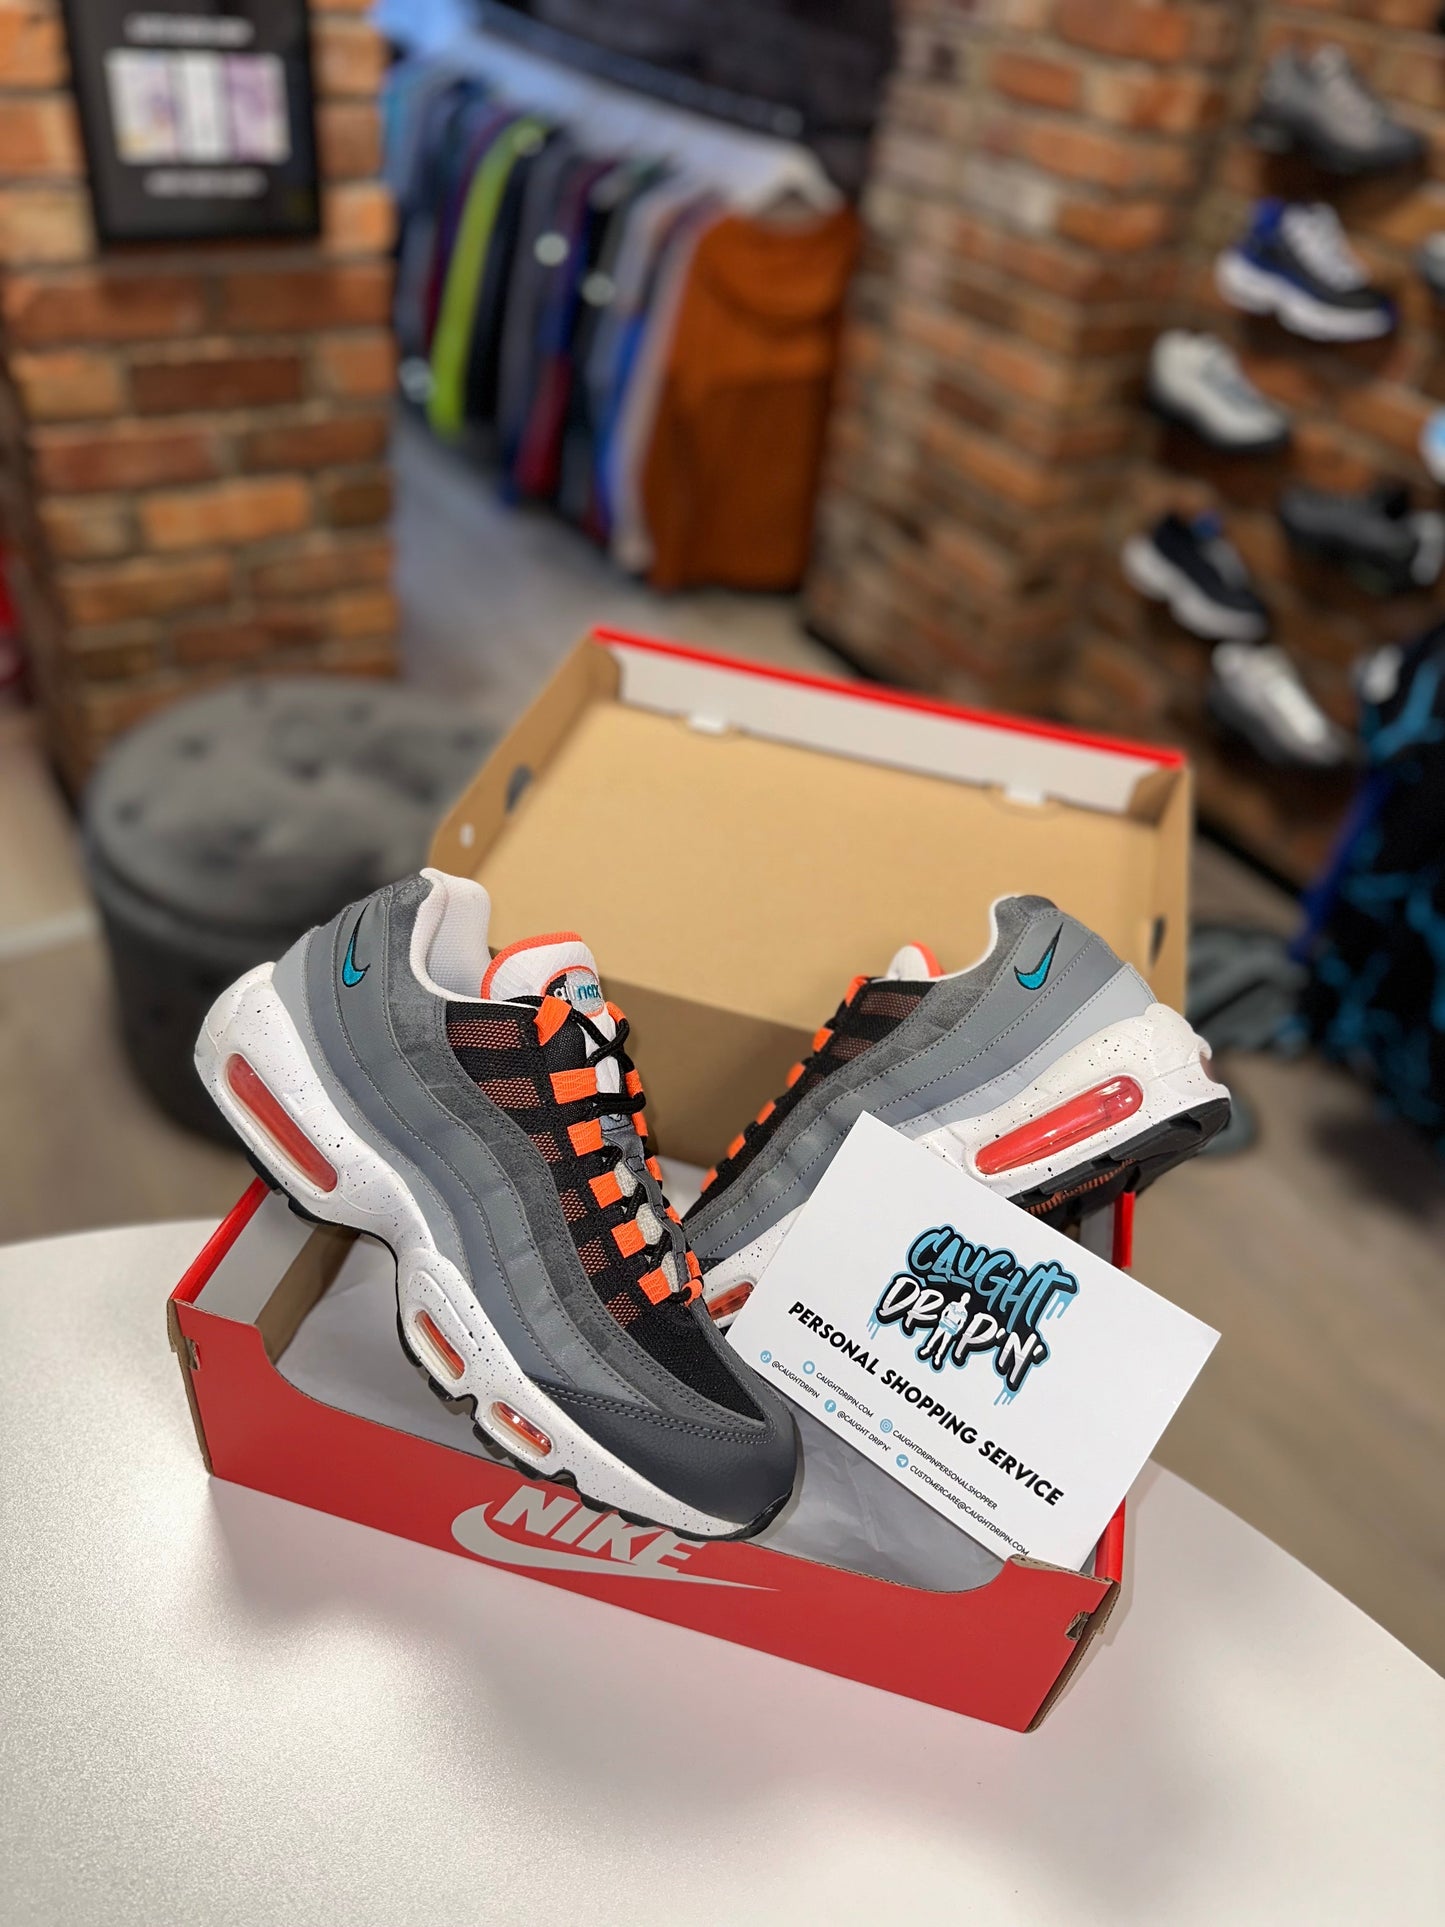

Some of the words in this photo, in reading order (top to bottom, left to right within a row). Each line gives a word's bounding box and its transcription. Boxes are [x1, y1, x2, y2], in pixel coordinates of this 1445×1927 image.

[909, 1227, 1075, 1333] CAUGHT
[771, 1360, 820, 1398] @CAUGHTDRIPIN
[788, 1301, 880, 1375] PERSONAL
[880, 1369, 978, 1444] SHOPPING
[978, 1440, 1064, 1506] SERVICE
[816, 1372, 874, 1418] CAUGHTDRIPIN.COM
[837, 1410, 869, 1437] @CAUGHT
[892, 1430, 998, 1510] CAUGHTDRIPINPERSONALSHOPPER
[909, 1465, 1030, 1556] CUSTOMERCARE@CAUGHTDRIPIN.COM
[492, 1484, 707, 1573] NIKE
